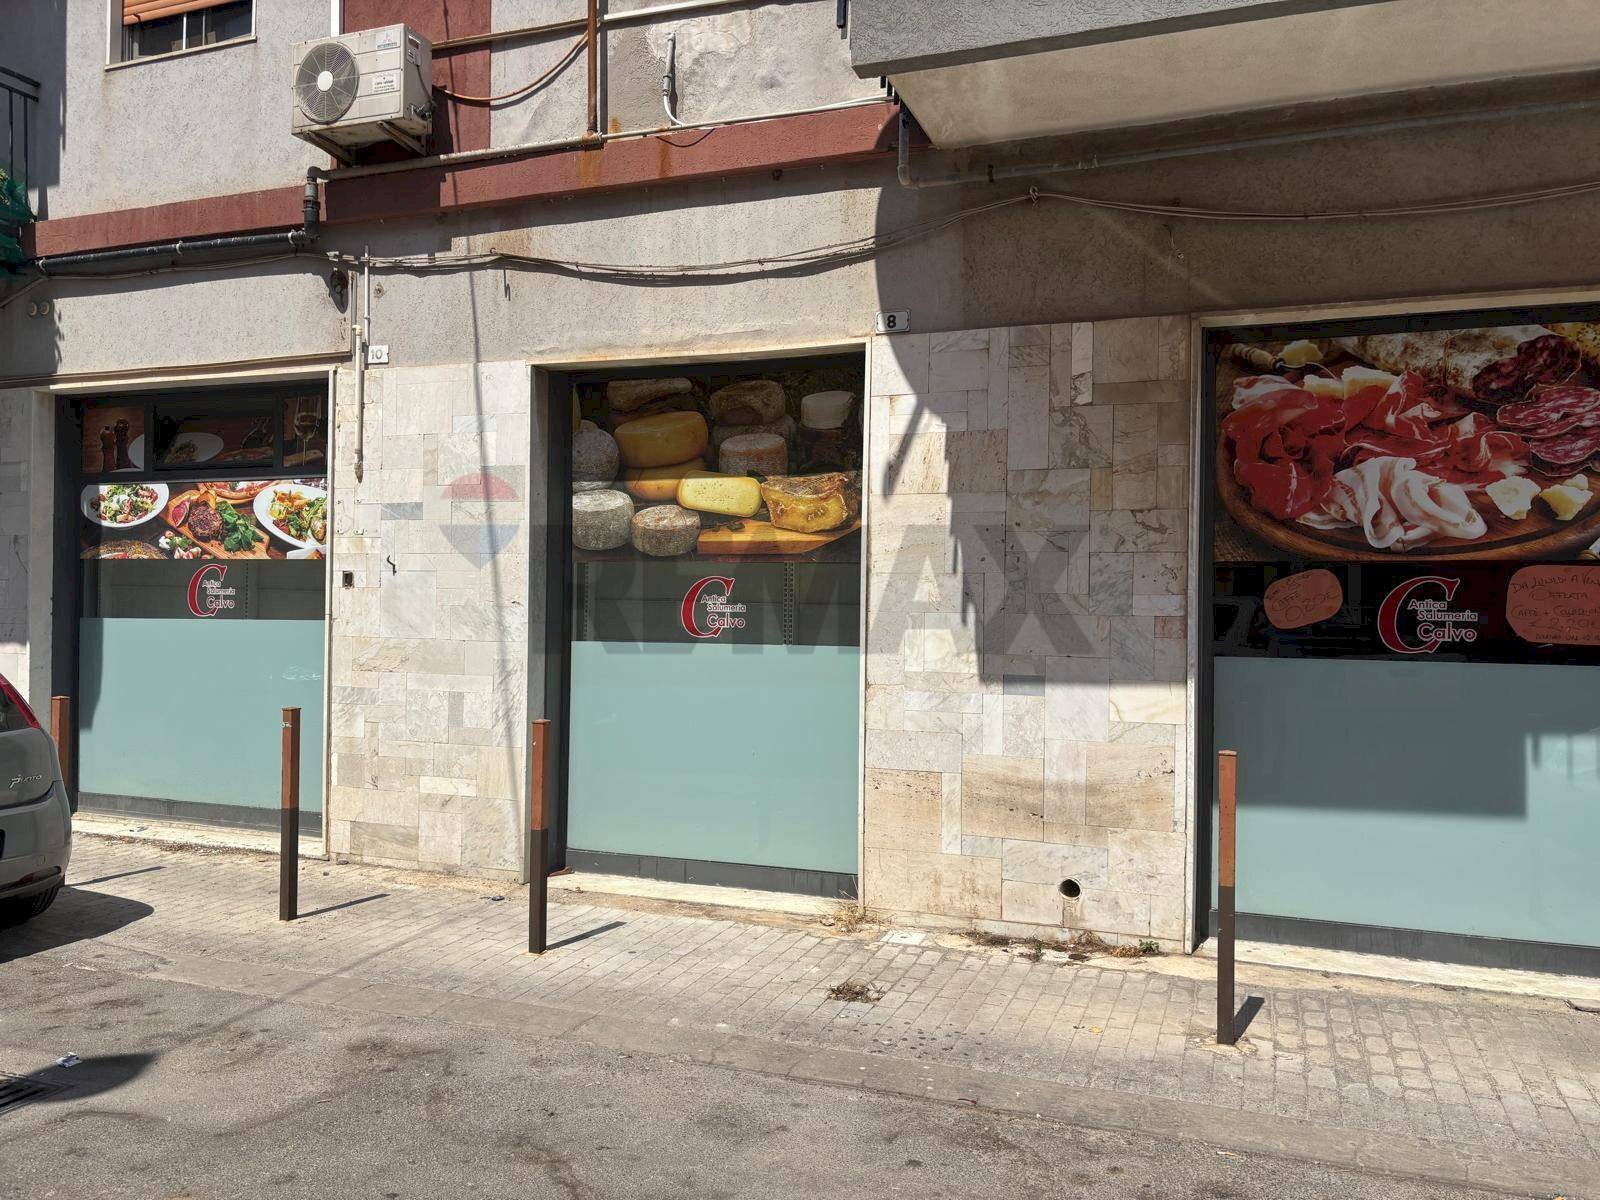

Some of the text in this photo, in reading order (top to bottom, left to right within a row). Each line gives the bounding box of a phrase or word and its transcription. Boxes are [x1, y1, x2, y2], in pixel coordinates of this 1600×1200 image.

[886, 314, 897, 329] 8
[370, 348, 383, 360] 10
[206, 595, 235, 609] Calvo
[701, 594, 727, 604] Antica
[1407, 599, 1448, 610] Antica
[706, 603, 746, 612] Salumeria
[706, 612, 746, 628] Calvo
[1416, 609, 1479, 621] Salumeria
[1416, 621, 1477, 642] Calvo
